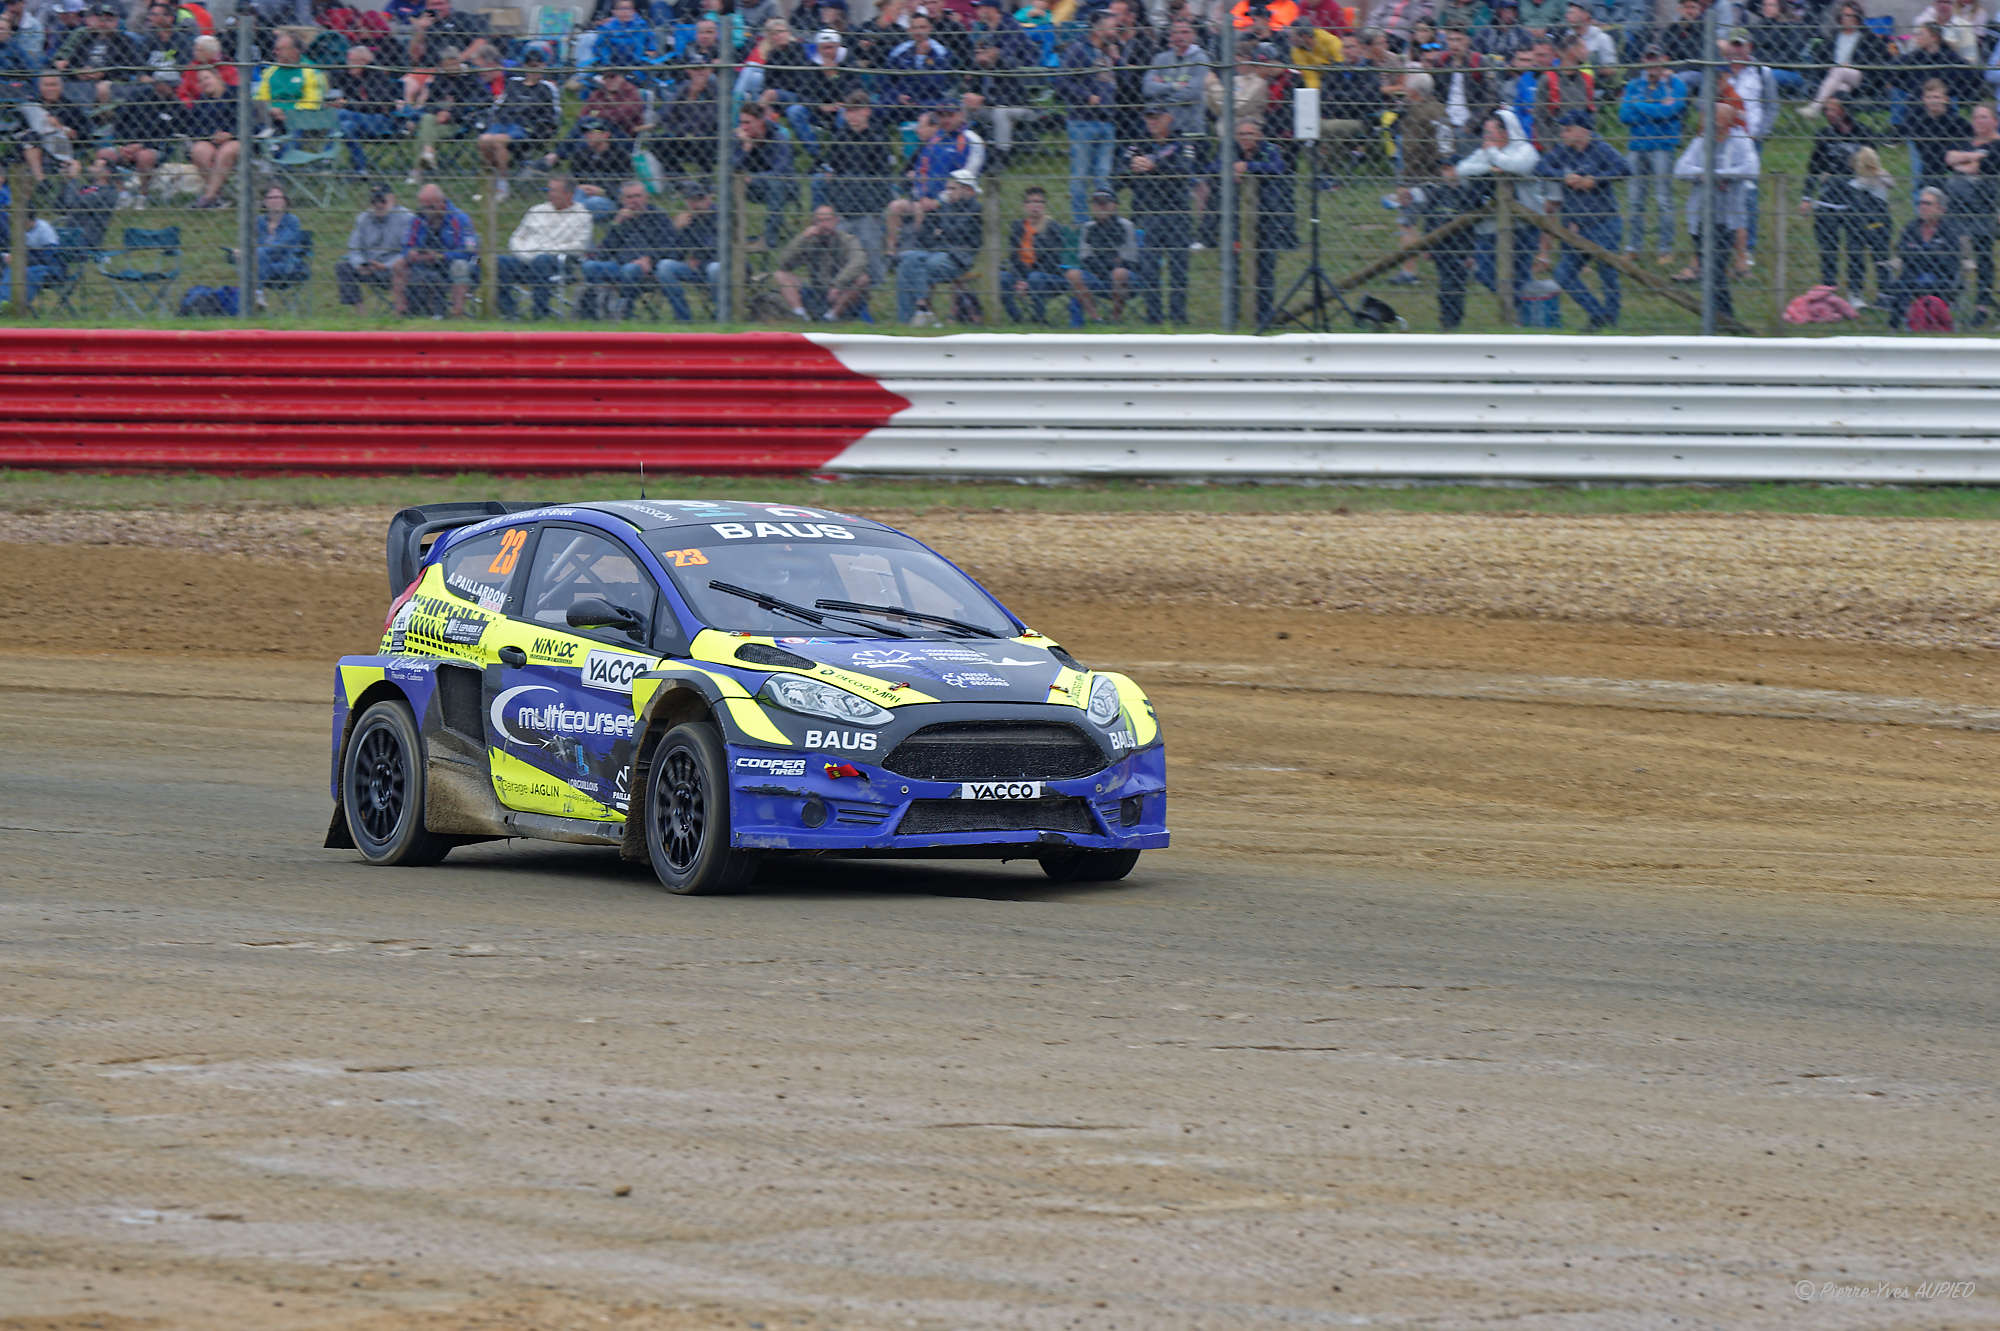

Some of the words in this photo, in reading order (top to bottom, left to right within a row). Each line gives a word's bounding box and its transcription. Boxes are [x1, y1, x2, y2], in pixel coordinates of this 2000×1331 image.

[710, 522, 855, 540] BAUS
[488, 528, 527, 575] 23
[665, 548, 709, 567] 23
[804, 730, 878, 750] BAUS
[1109, 730, 1136, 750] BAUS
[735, 758, 806, 769] COOPER
[769, 768, 805, 776] TIRES
[530, 783, 560, 798] JAGLIN
[970, 784, 1033, 799] YACCO
